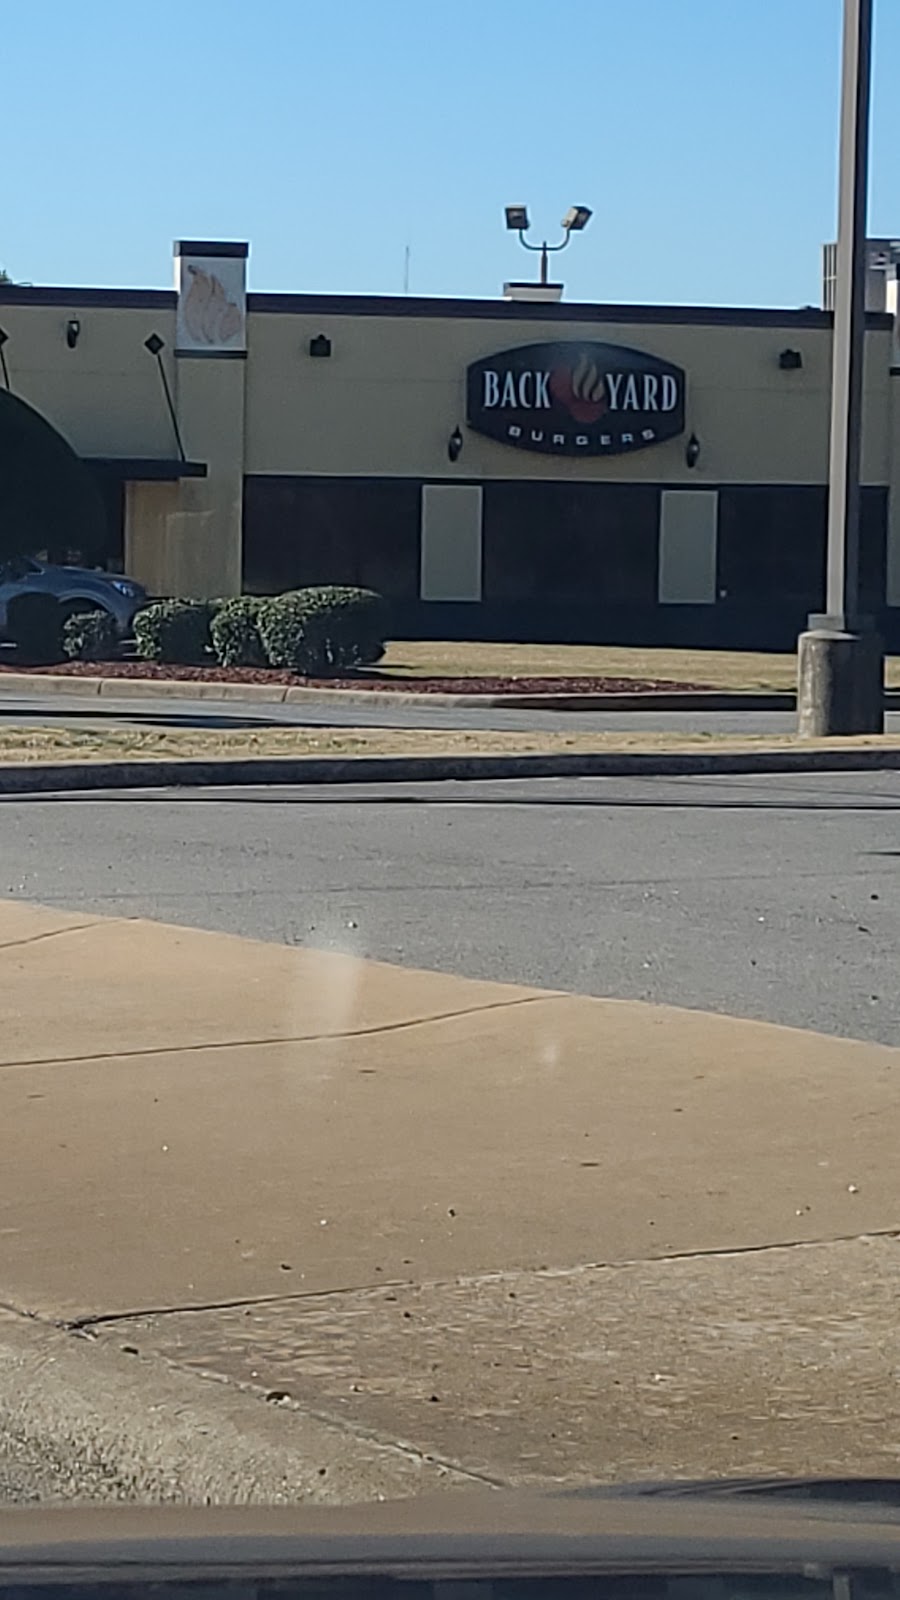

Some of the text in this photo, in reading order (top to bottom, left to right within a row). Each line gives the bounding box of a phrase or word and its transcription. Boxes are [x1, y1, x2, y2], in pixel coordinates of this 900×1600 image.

[483, 370, 678, 411] BACK YARD
[508, 425, 656, 445] BURGERS
